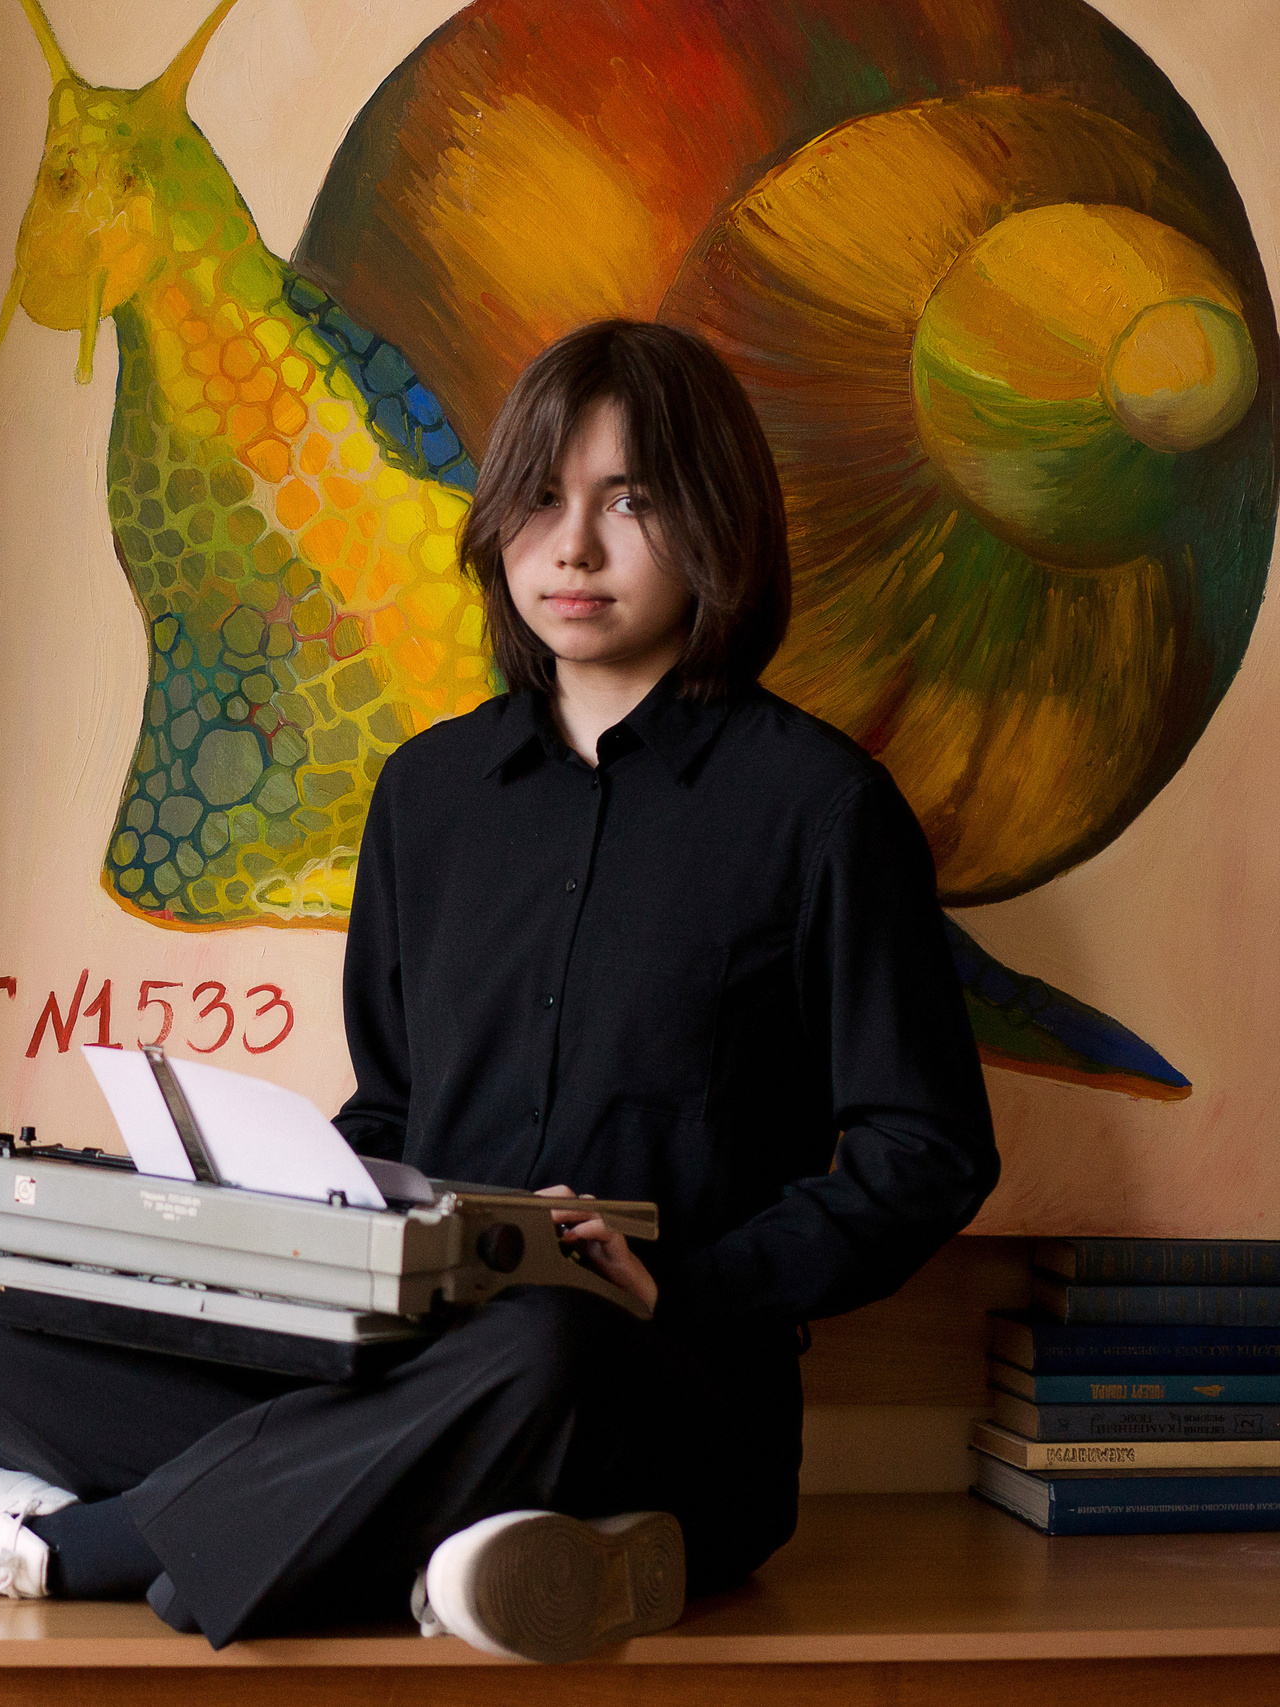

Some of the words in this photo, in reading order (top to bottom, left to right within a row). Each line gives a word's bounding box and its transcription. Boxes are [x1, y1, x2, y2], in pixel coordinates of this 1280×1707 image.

[1090, 1384, 1127, 1399] ГОВАРД
[1131, 1384, 1165, 1399] РОБЕРТ
[1119, 1414, 1152, 1424] ПОЯС
[1096, 1424, 1175, 1435] КАМЕННЫЙ
[1077, 1505, 1124, 1514] АКАДЕМИЯ
